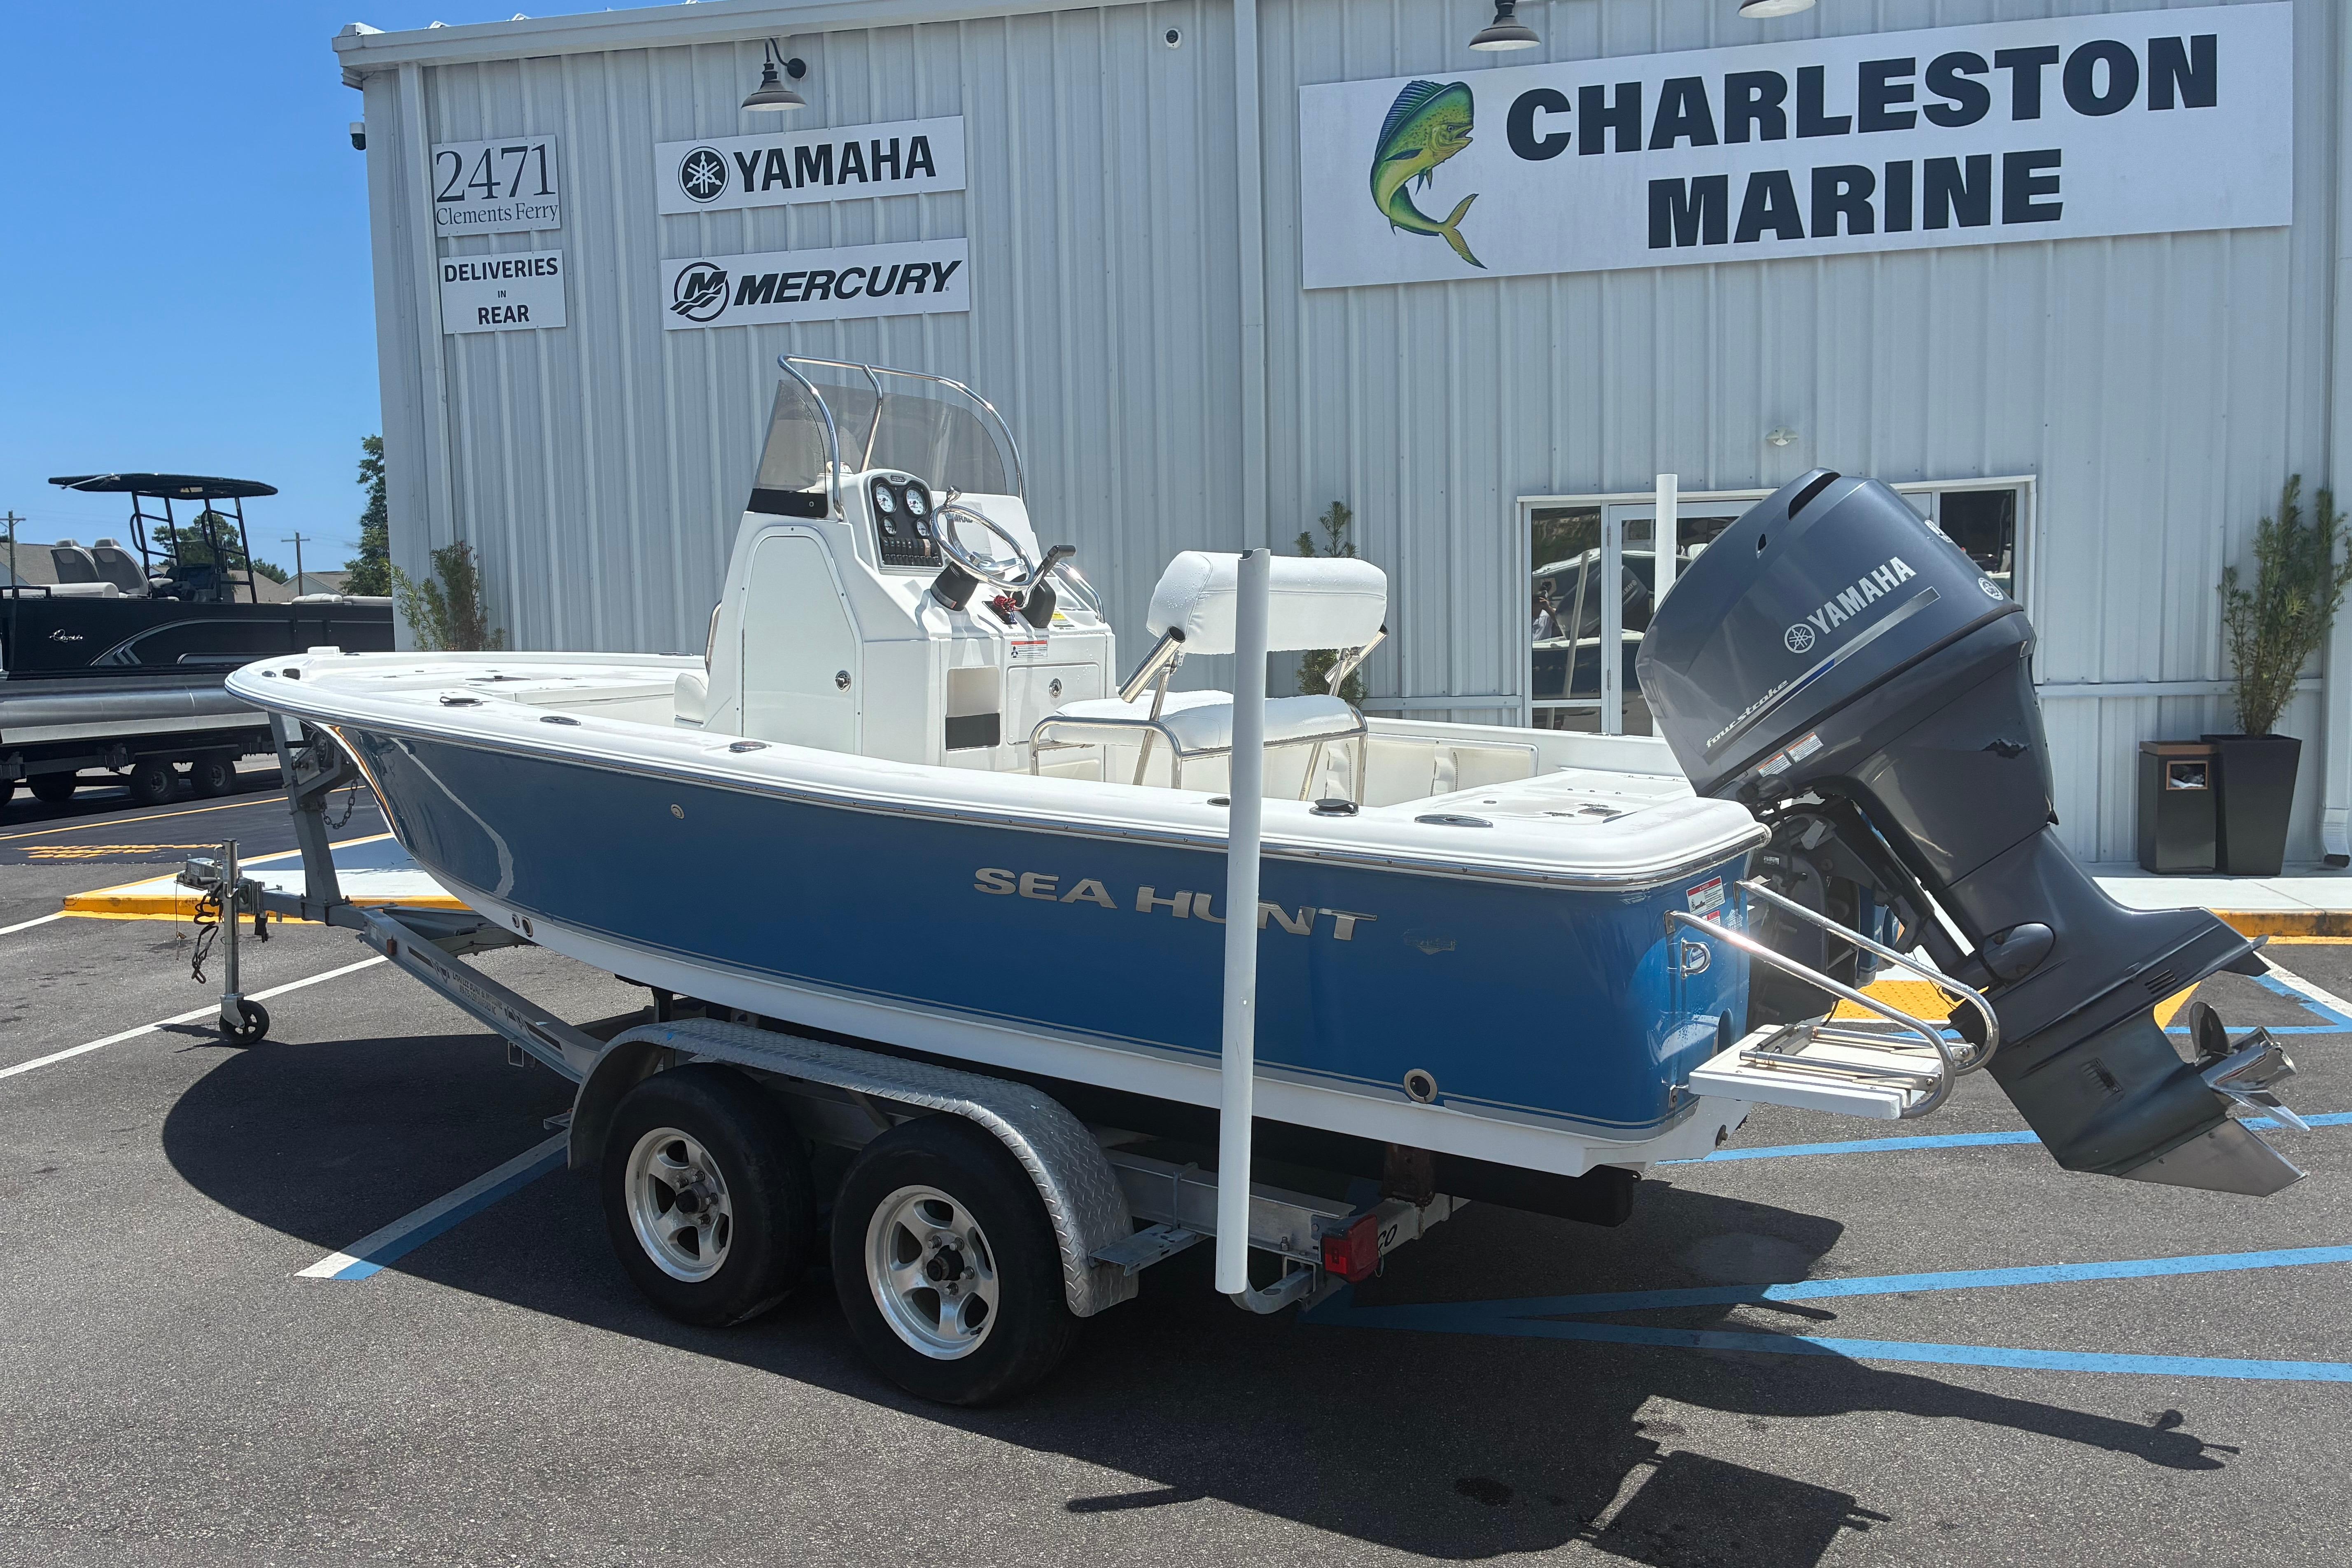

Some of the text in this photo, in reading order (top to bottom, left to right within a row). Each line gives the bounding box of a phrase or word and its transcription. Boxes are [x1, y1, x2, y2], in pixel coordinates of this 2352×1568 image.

[1507, 34, 2217, 161] CHARLESTON
[436, 143, 556, 203] 2471
[733, 135, 936, 193] YAMAHA
[436, 203, 558, 225] Clements Ferry
[1648, 148, 2063, 249] MARINE
[444, 257, 558, 282] DELIVERIES
[733, 260, 963, 306] MERCURY
[478, 304, 530, 325] REAR
[497, 290, 506, 299] IN
[1806, 556, 1917, 634] YAMAHA
[973, 867, 1118, 909] SEA
